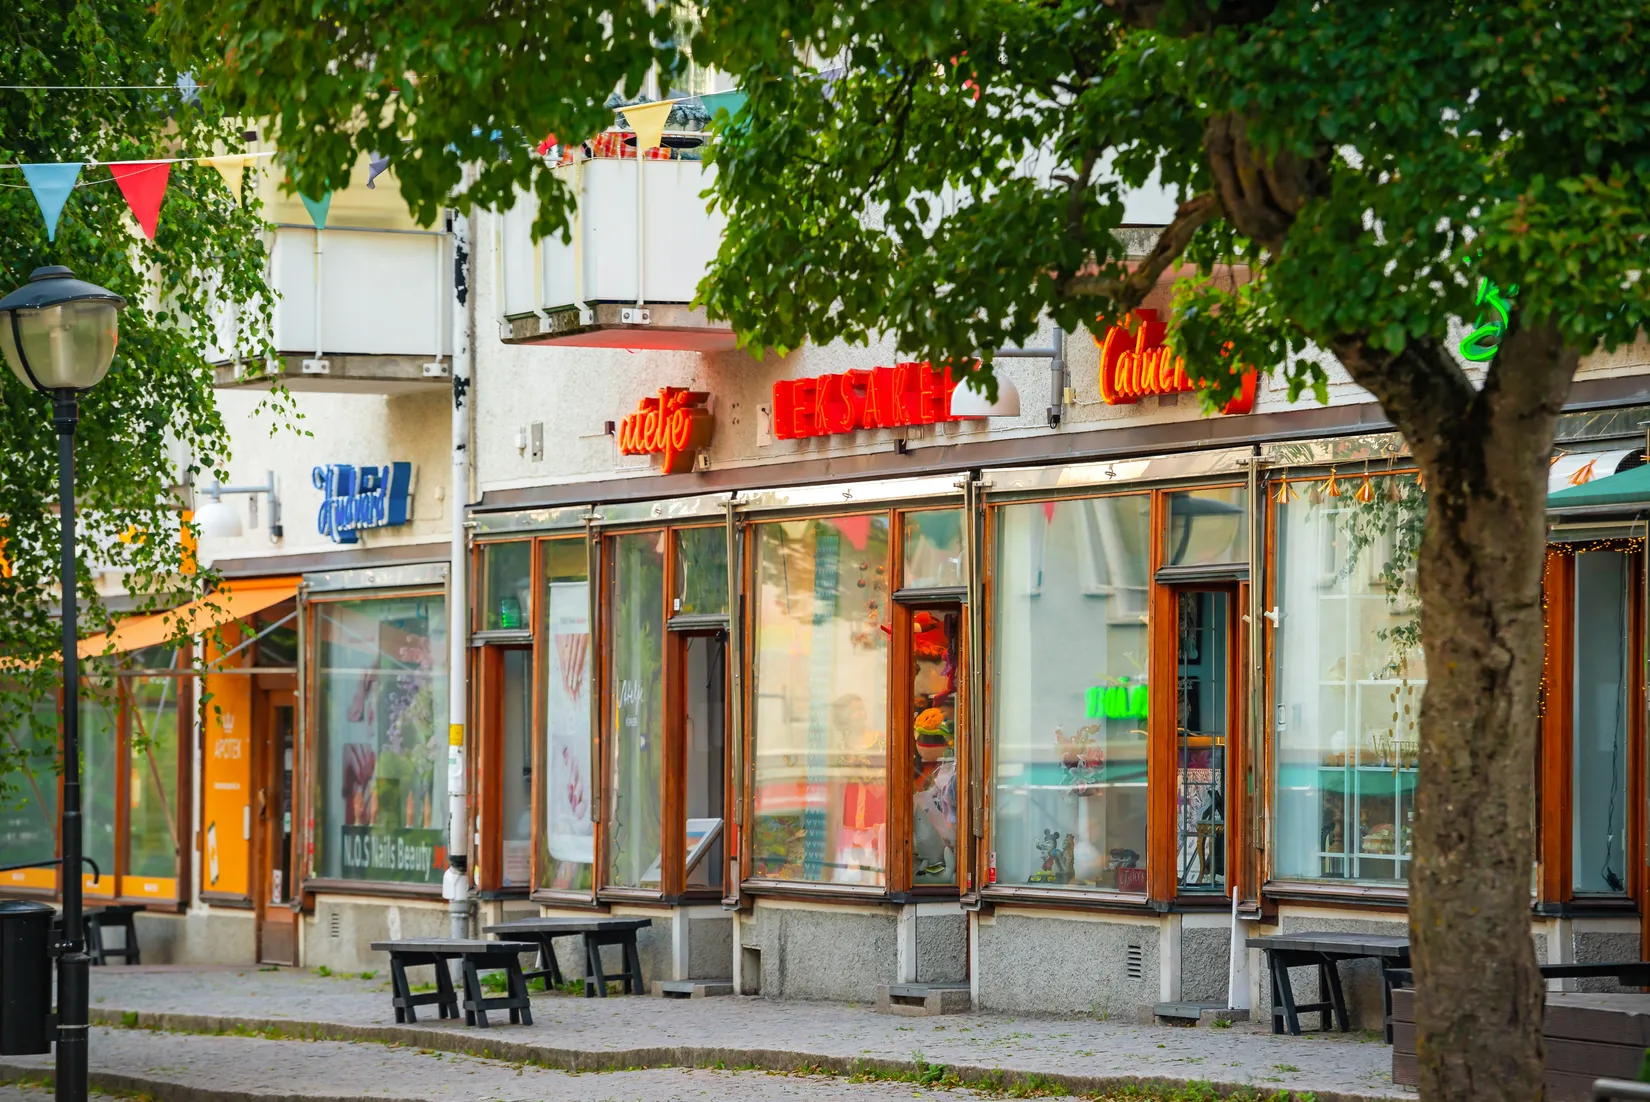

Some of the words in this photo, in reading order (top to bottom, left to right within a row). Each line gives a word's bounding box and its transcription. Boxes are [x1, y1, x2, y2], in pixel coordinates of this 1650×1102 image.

[214, 738, 242, 760] APOTEK
[372, 834, 396, 870] Nails
[397, 836, 432, 882] Beauty
